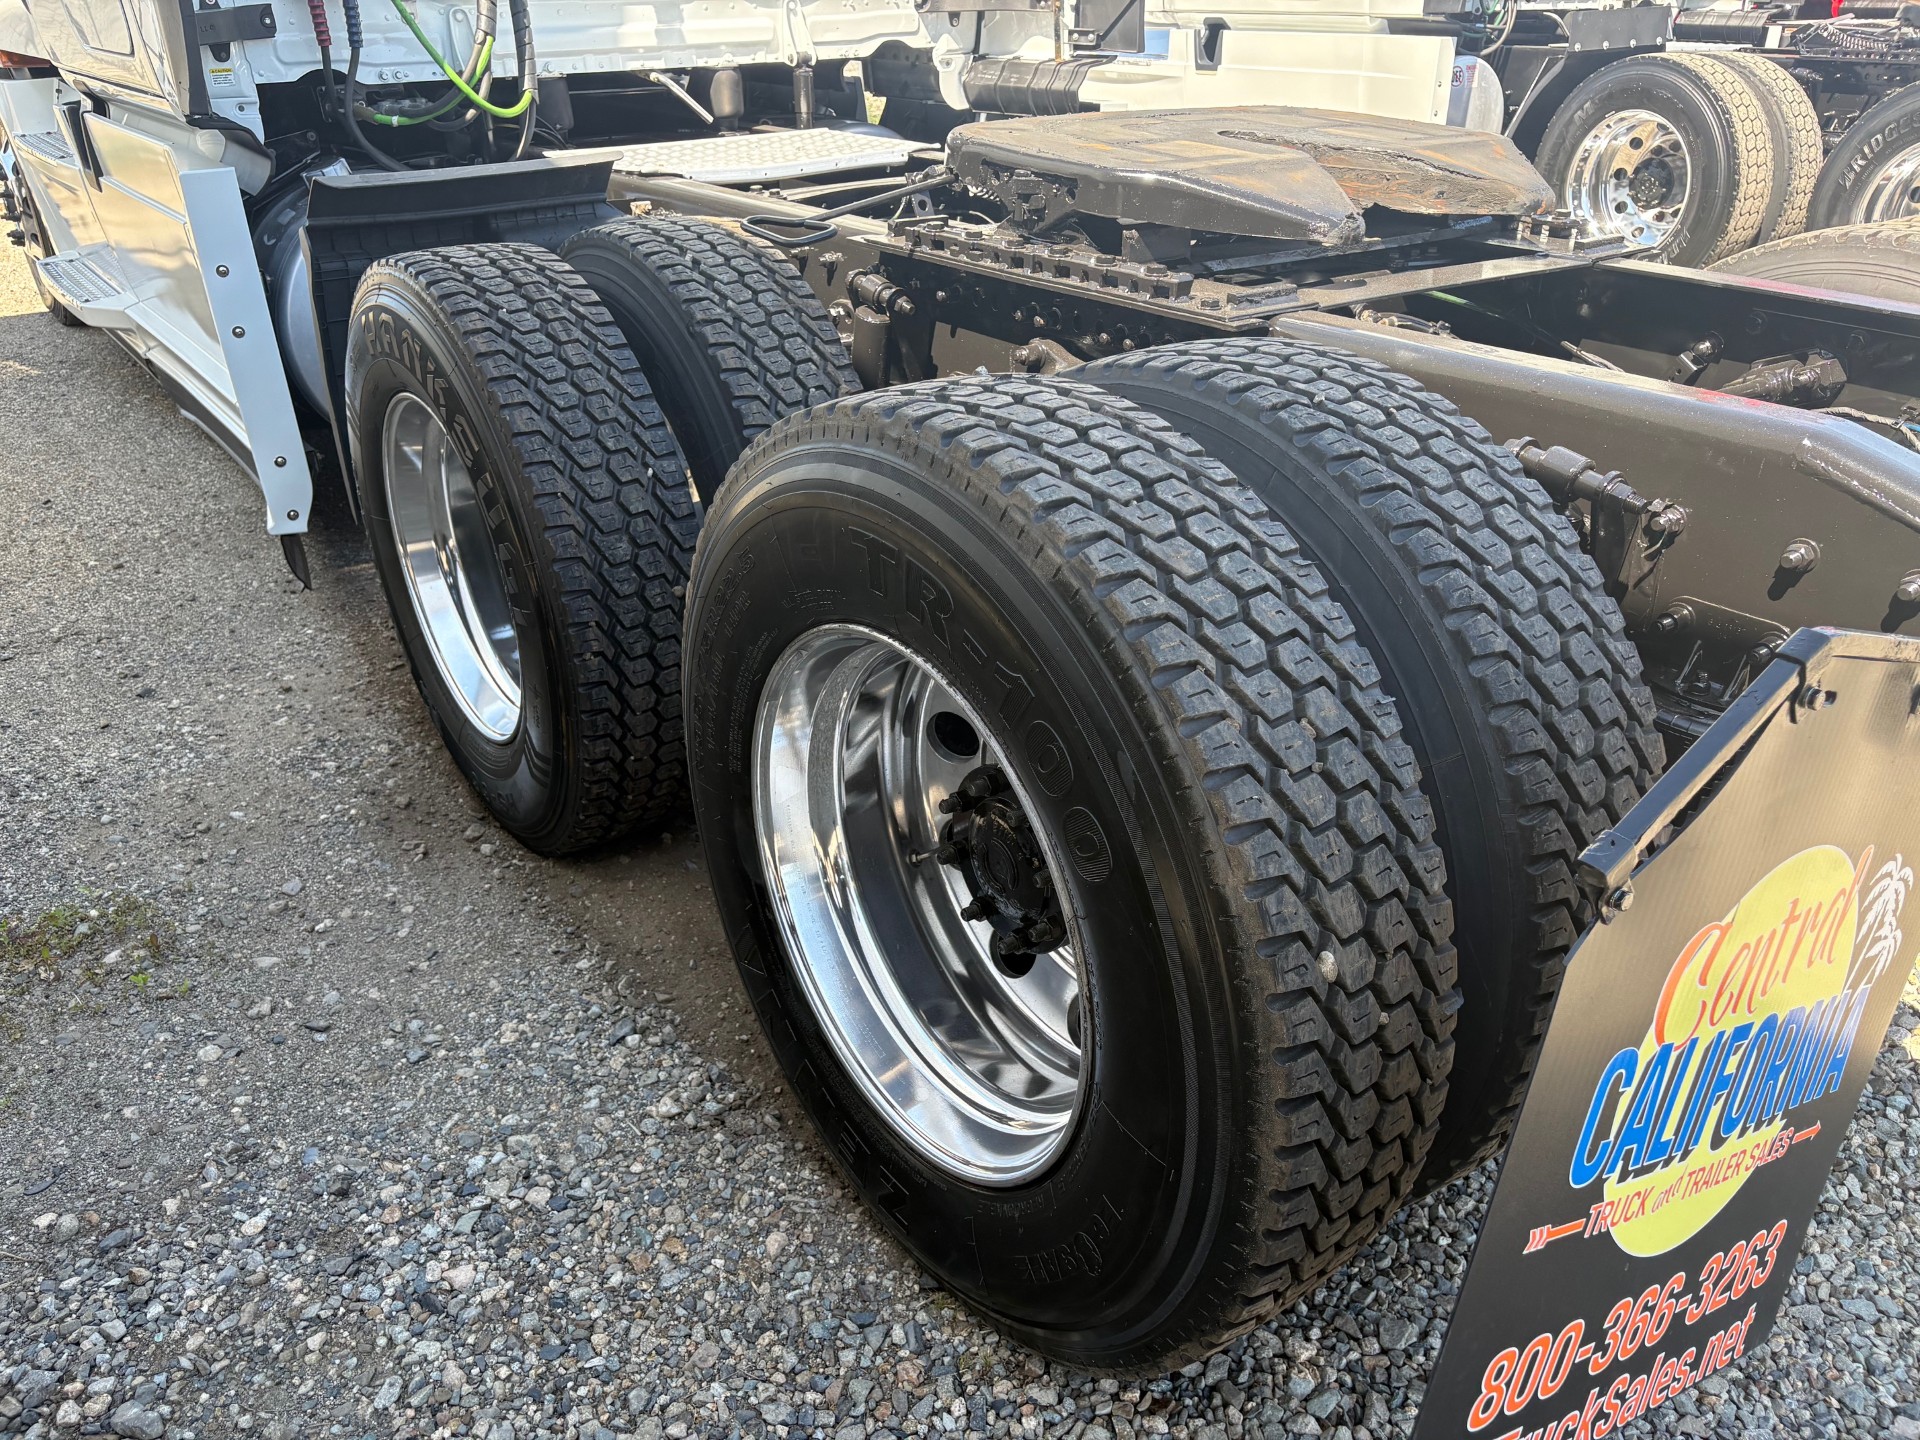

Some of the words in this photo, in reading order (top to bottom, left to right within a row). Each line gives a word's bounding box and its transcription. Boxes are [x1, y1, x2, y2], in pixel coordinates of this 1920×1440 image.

[848, 526, 1112, 882] TR-100
[1654, 844, 1875, 1053] Central
[1569, 984, 1870, 1189] CALIFORNIA
[1584, 1185, 1655, 1238] TRUCK
[1651, 1163, 1689, 1215] and
[1680, 1148, 1748, 1200] TRAILER
[1743, 1127, 1794, 1173] SALES
[1466, 1219, 1788, 1433] 800-366-3263
[1492, 1304, 1755, 1440] ckSales.net
